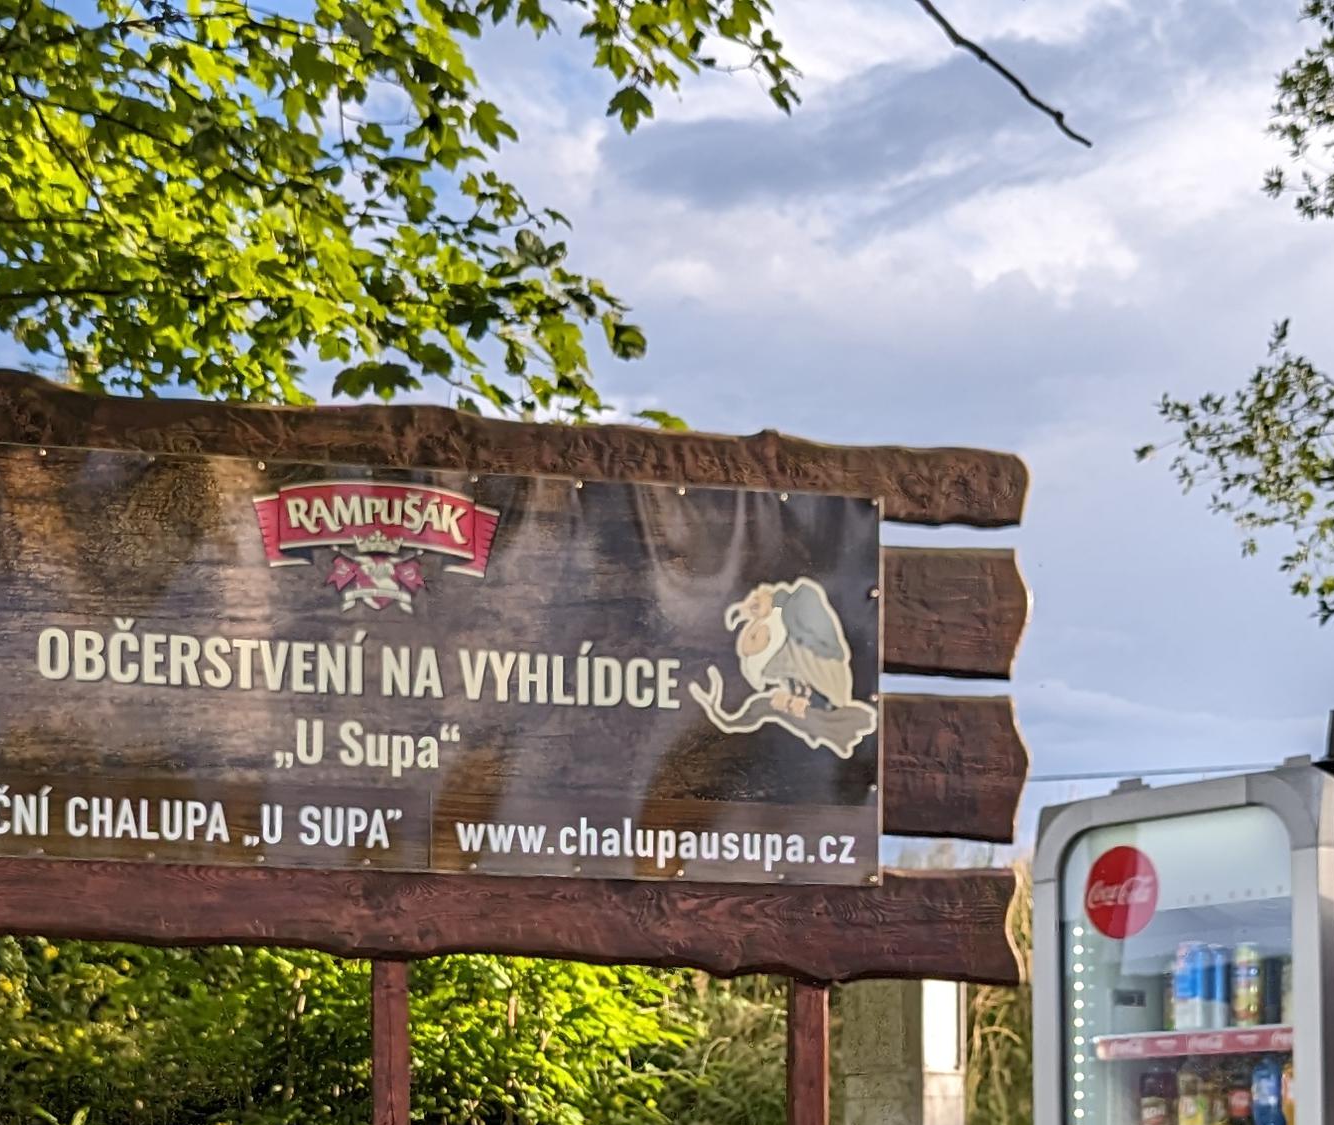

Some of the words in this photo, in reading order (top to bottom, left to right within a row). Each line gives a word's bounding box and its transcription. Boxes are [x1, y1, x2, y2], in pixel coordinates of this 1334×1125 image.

[285, 492, 470, 546] RAMPUŠÁK
[38, 617, 368, 696] OBČERSTVENÍ
[381, 645, 444, 699] NA
[458, 640, 681, 709] VYHLÍDCE
[67, 796, 230, 843] CHALUPA
[455, 816, 857, 872] www.chalupausupa.cz
